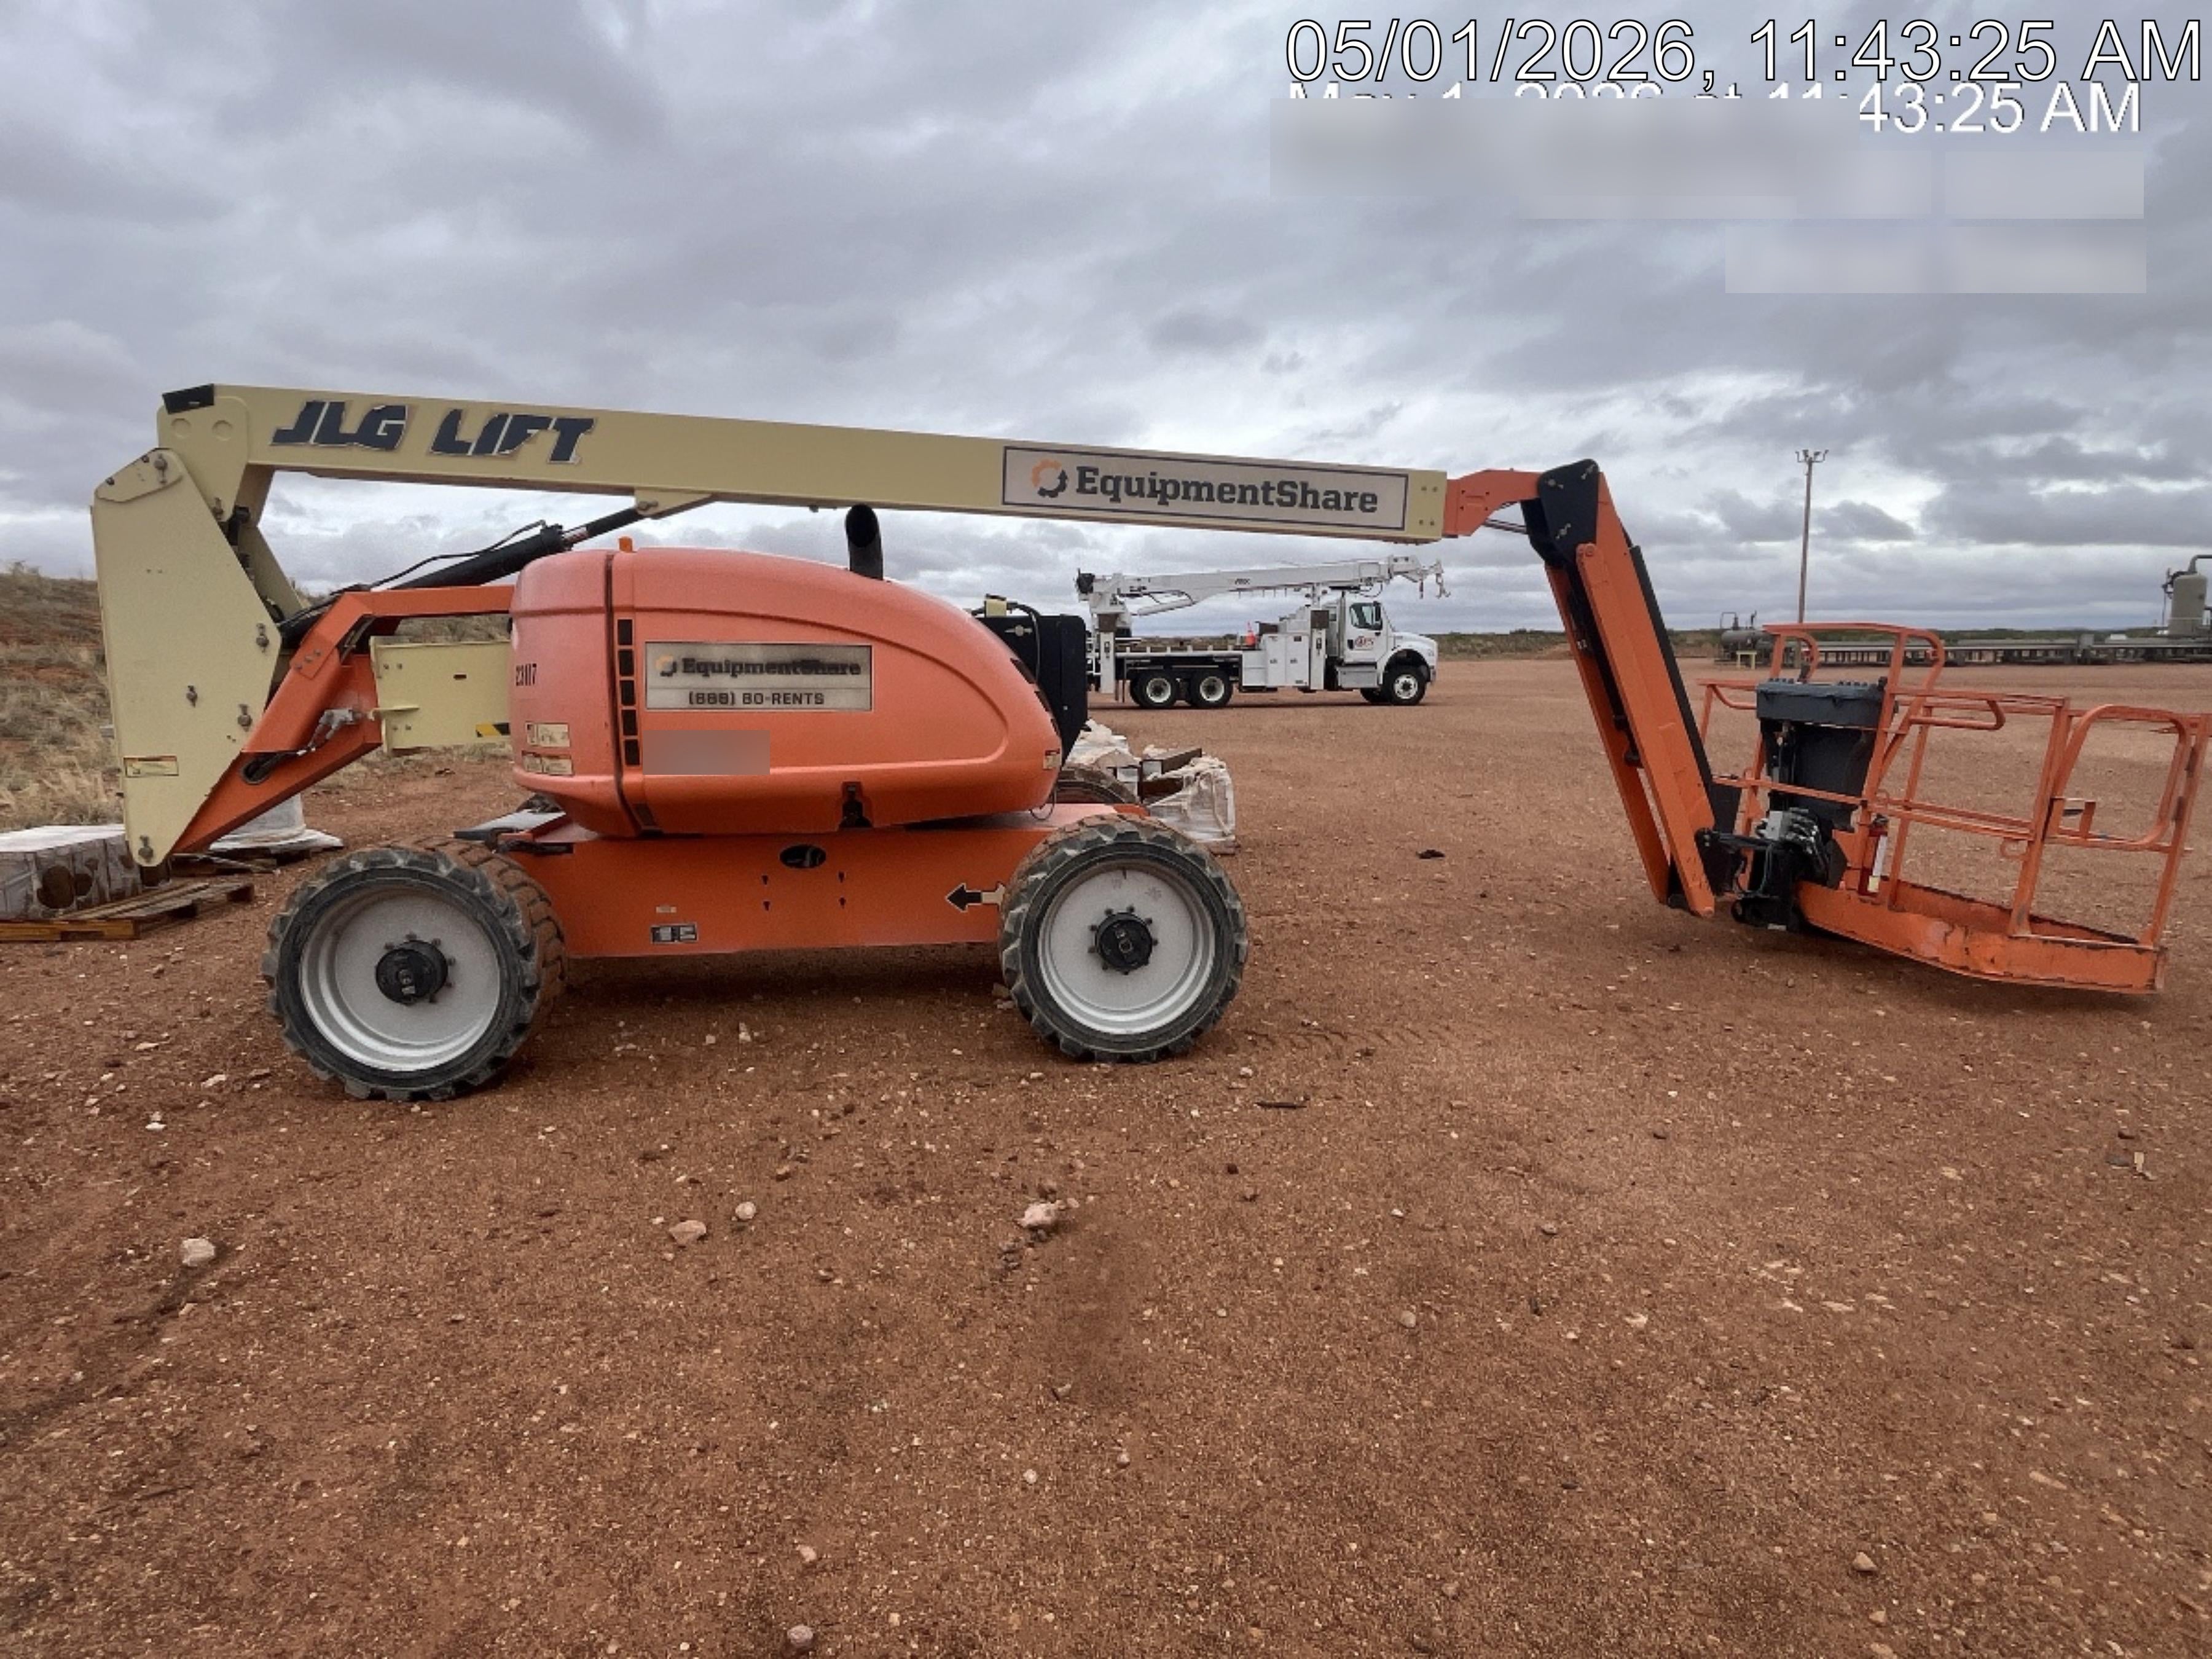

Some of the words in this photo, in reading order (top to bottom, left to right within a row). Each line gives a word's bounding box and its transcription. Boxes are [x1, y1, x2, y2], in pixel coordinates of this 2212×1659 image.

[270, 401, 408, 450] JLG
[430, 409, 594, 464] LIFT
[1076, 466, 1378, 513] EquipmentShare
[682, 657, 861, 678] EquipmentShare
